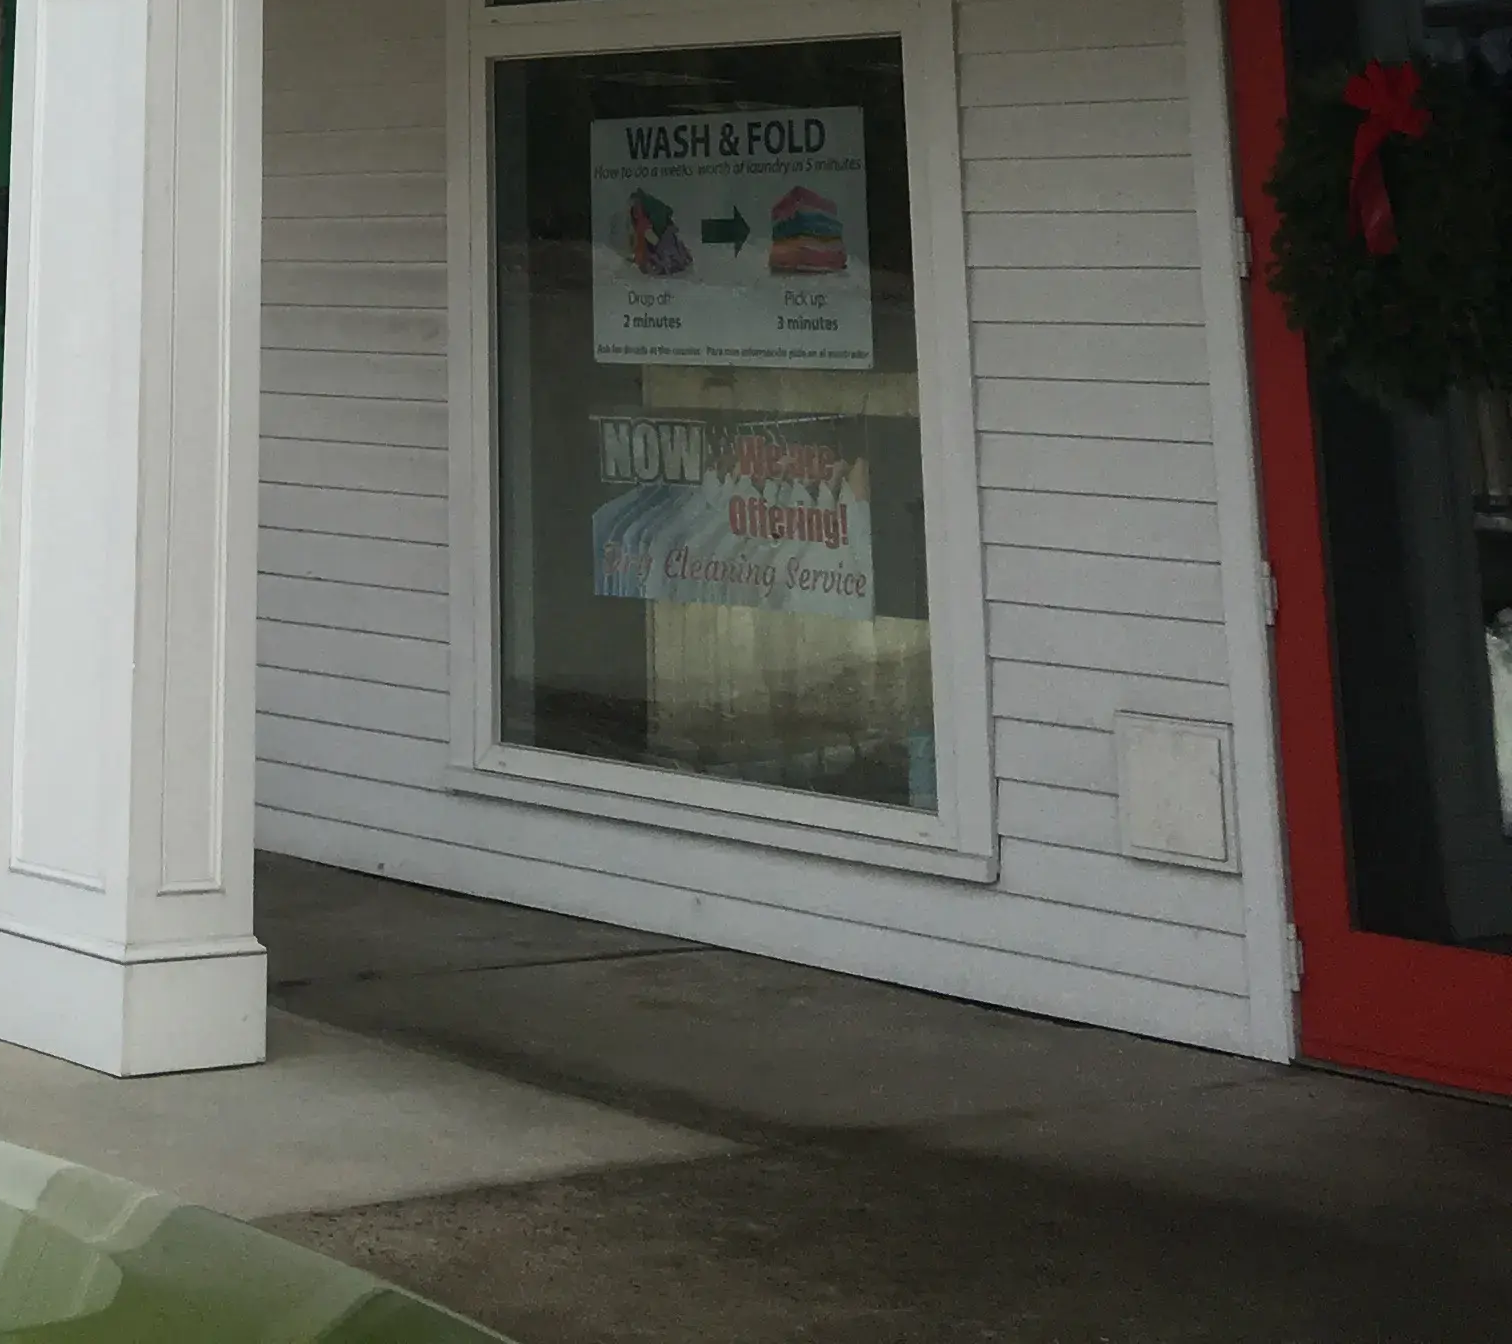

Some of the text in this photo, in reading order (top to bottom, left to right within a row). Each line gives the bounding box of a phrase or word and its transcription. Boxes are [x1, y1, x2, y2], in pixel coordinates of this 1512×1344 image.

[626, 118, 826, 160] WASH & FOLD
[747, 157, 788, 176] laundry
[628, 291, 655, 307] Drop
[785, 291, 808, 306] Pick
[623, 313, 682, 329] 2 minutes
[777, 315, 839, 331] 3 minutes
[602, 421, 702, 480] NOW
[728, 494, 849, 549] Offering!
[664, 545, 776, 598] Cleaning
[787, 556, 867, 598] Service
